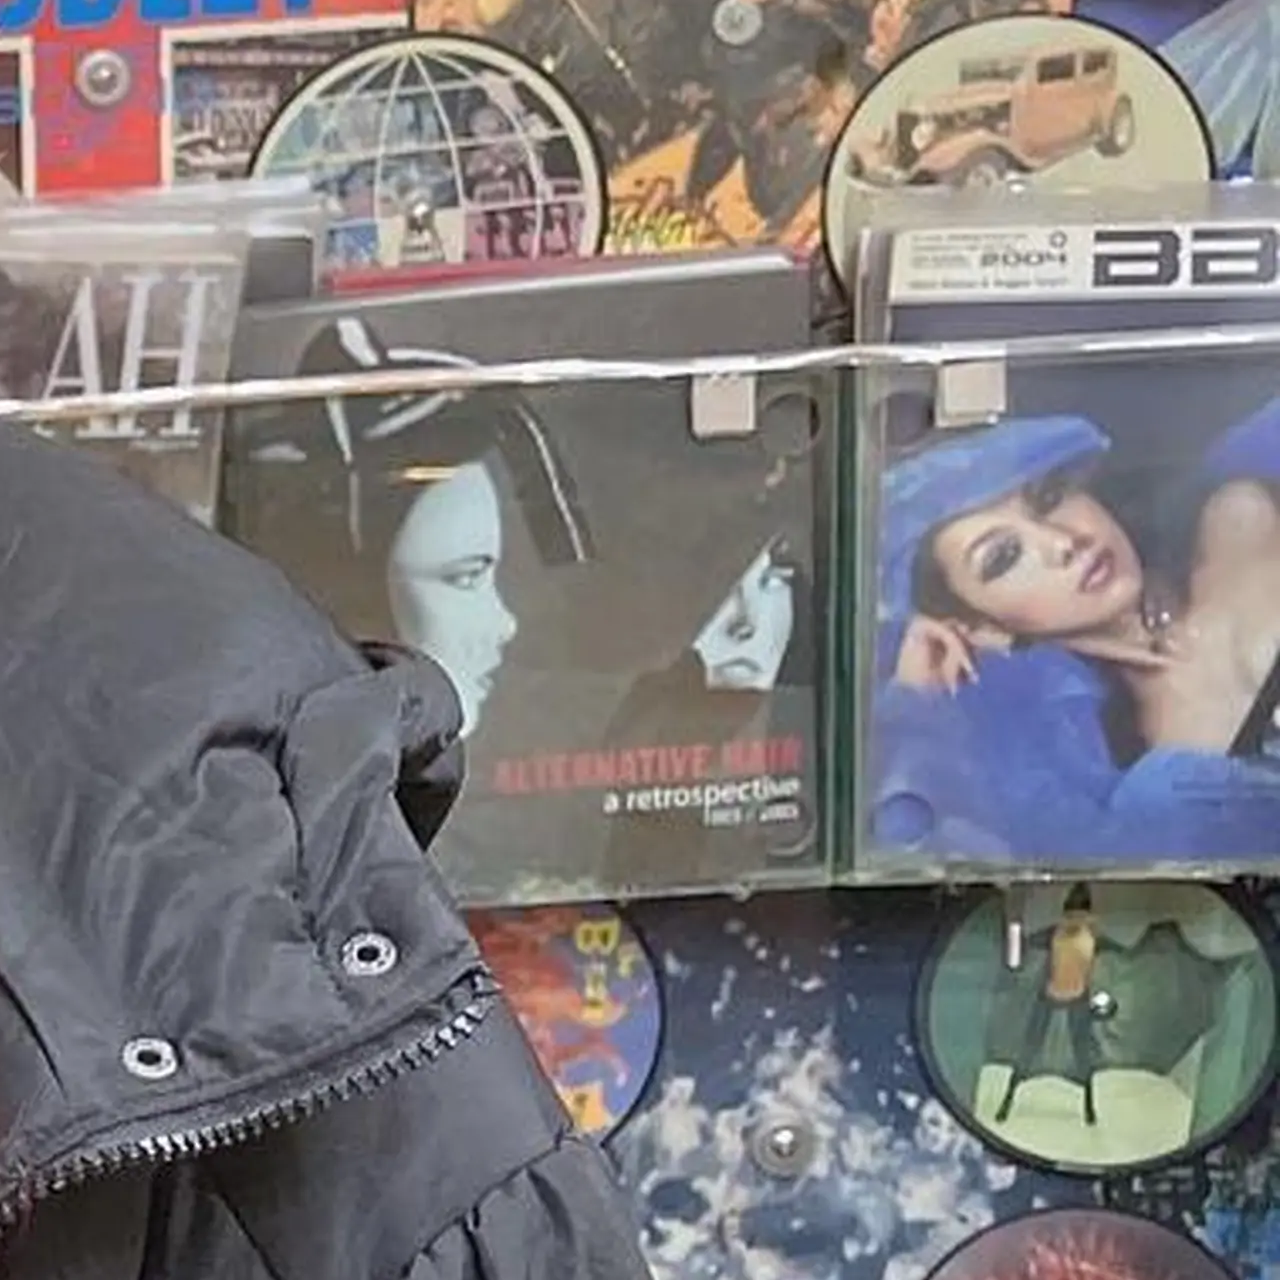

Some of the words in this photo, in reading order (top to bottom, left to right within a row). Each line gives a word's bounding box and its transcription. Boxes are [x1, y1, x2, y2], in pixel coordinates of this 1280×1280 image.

[33, 273, 220, 440] AH
[493, 743, 712, 795] ALTERNATIVE
[602, 792, 619, 814] a
[626, 776, 801, 826] retrospective
